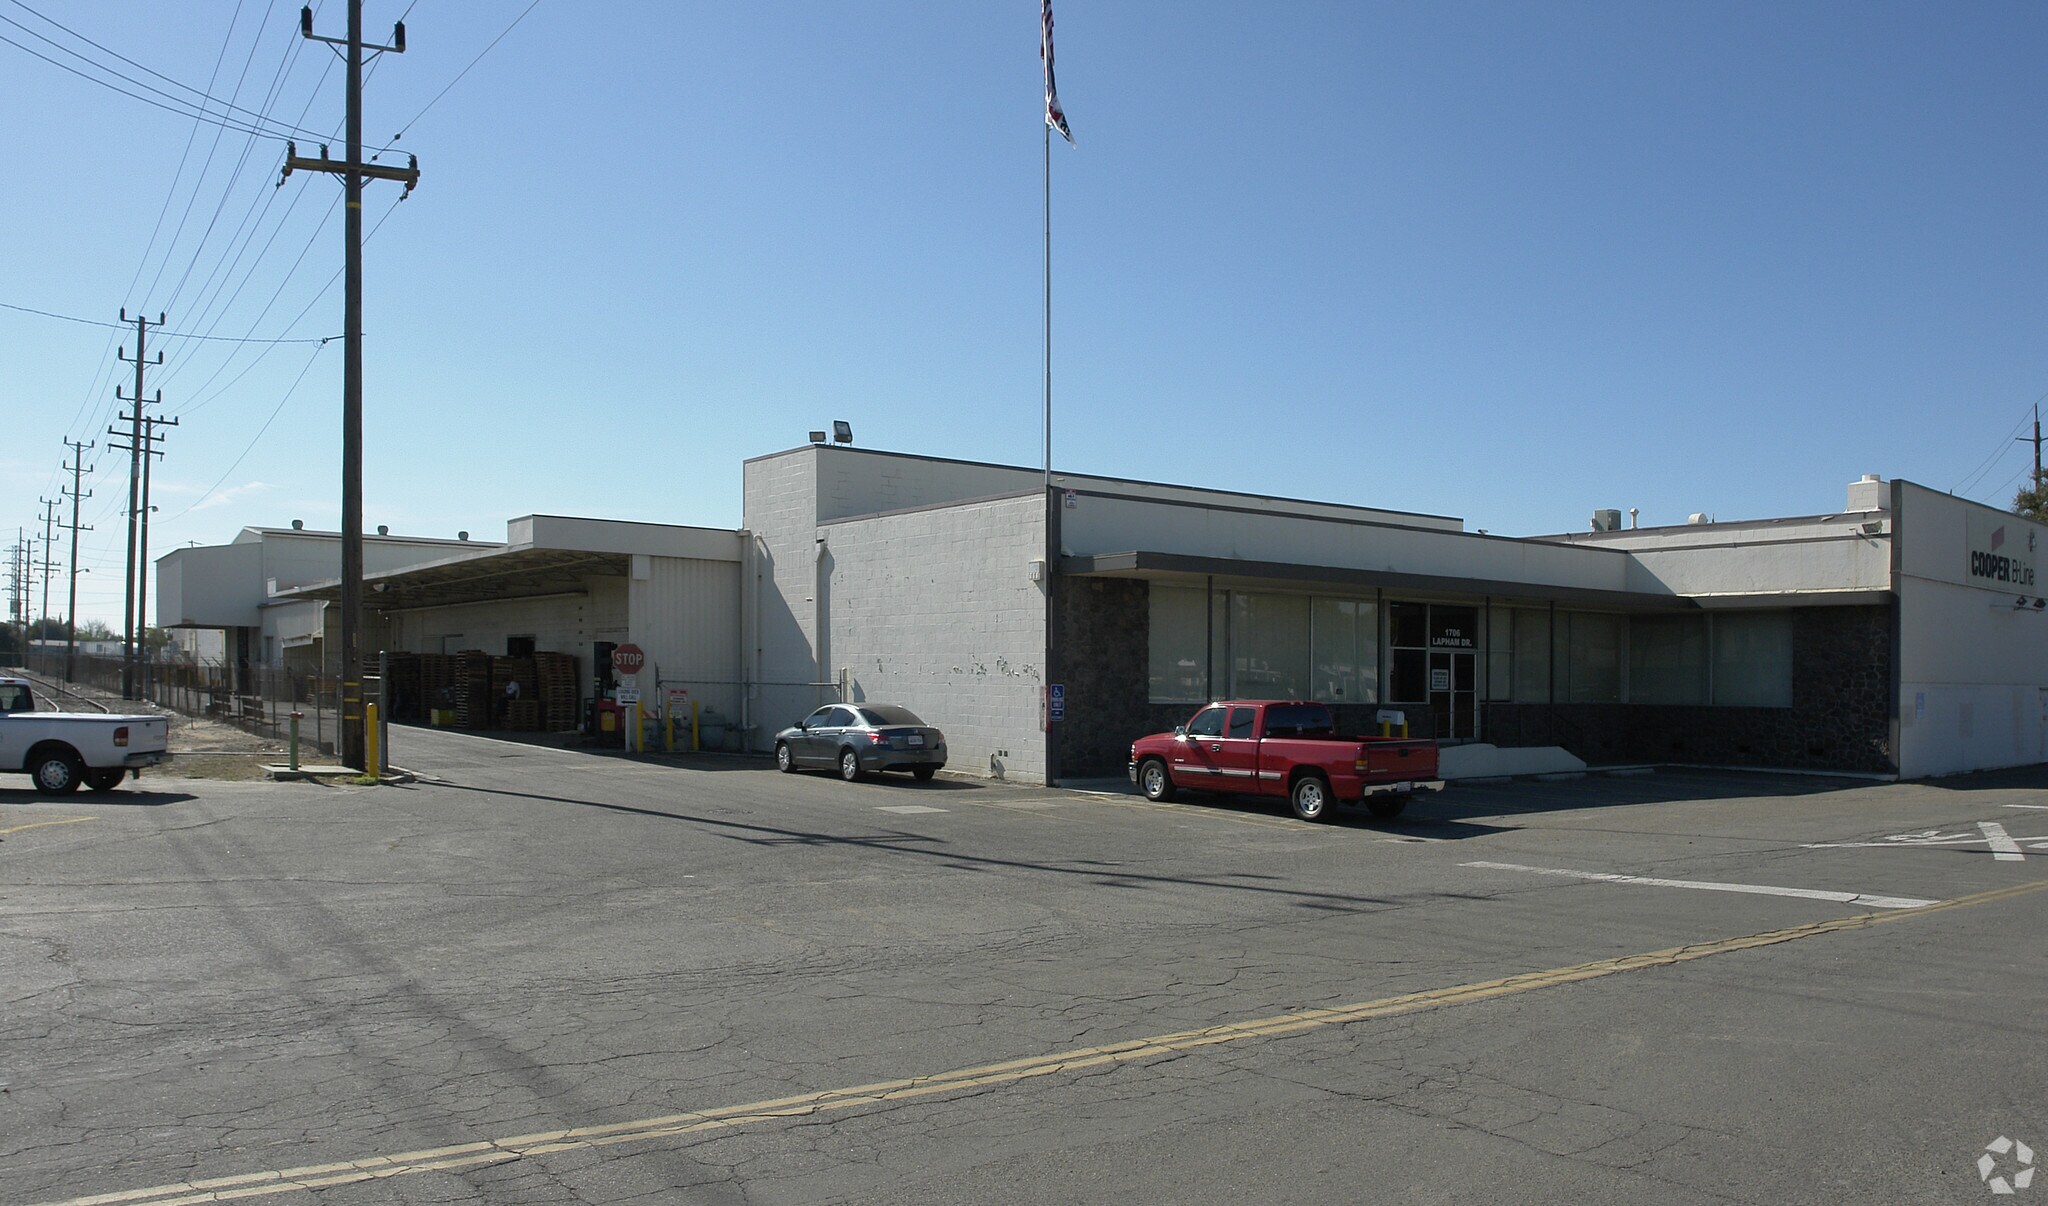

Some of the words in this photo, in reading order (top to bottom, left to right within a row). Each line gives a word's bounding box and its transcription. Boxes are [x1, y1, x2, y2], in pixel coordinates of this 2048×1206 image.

[1971, 550, 2010, 582] COOPER
[2012, 558, 2035, 586] B-Line
[1445, 628, 1461, 637] 1706
[1432, 637, 1460, 646] LAPHAM
[1461, 638, 1473, 647] DR.
[615, 653, 643, 665] STOP
